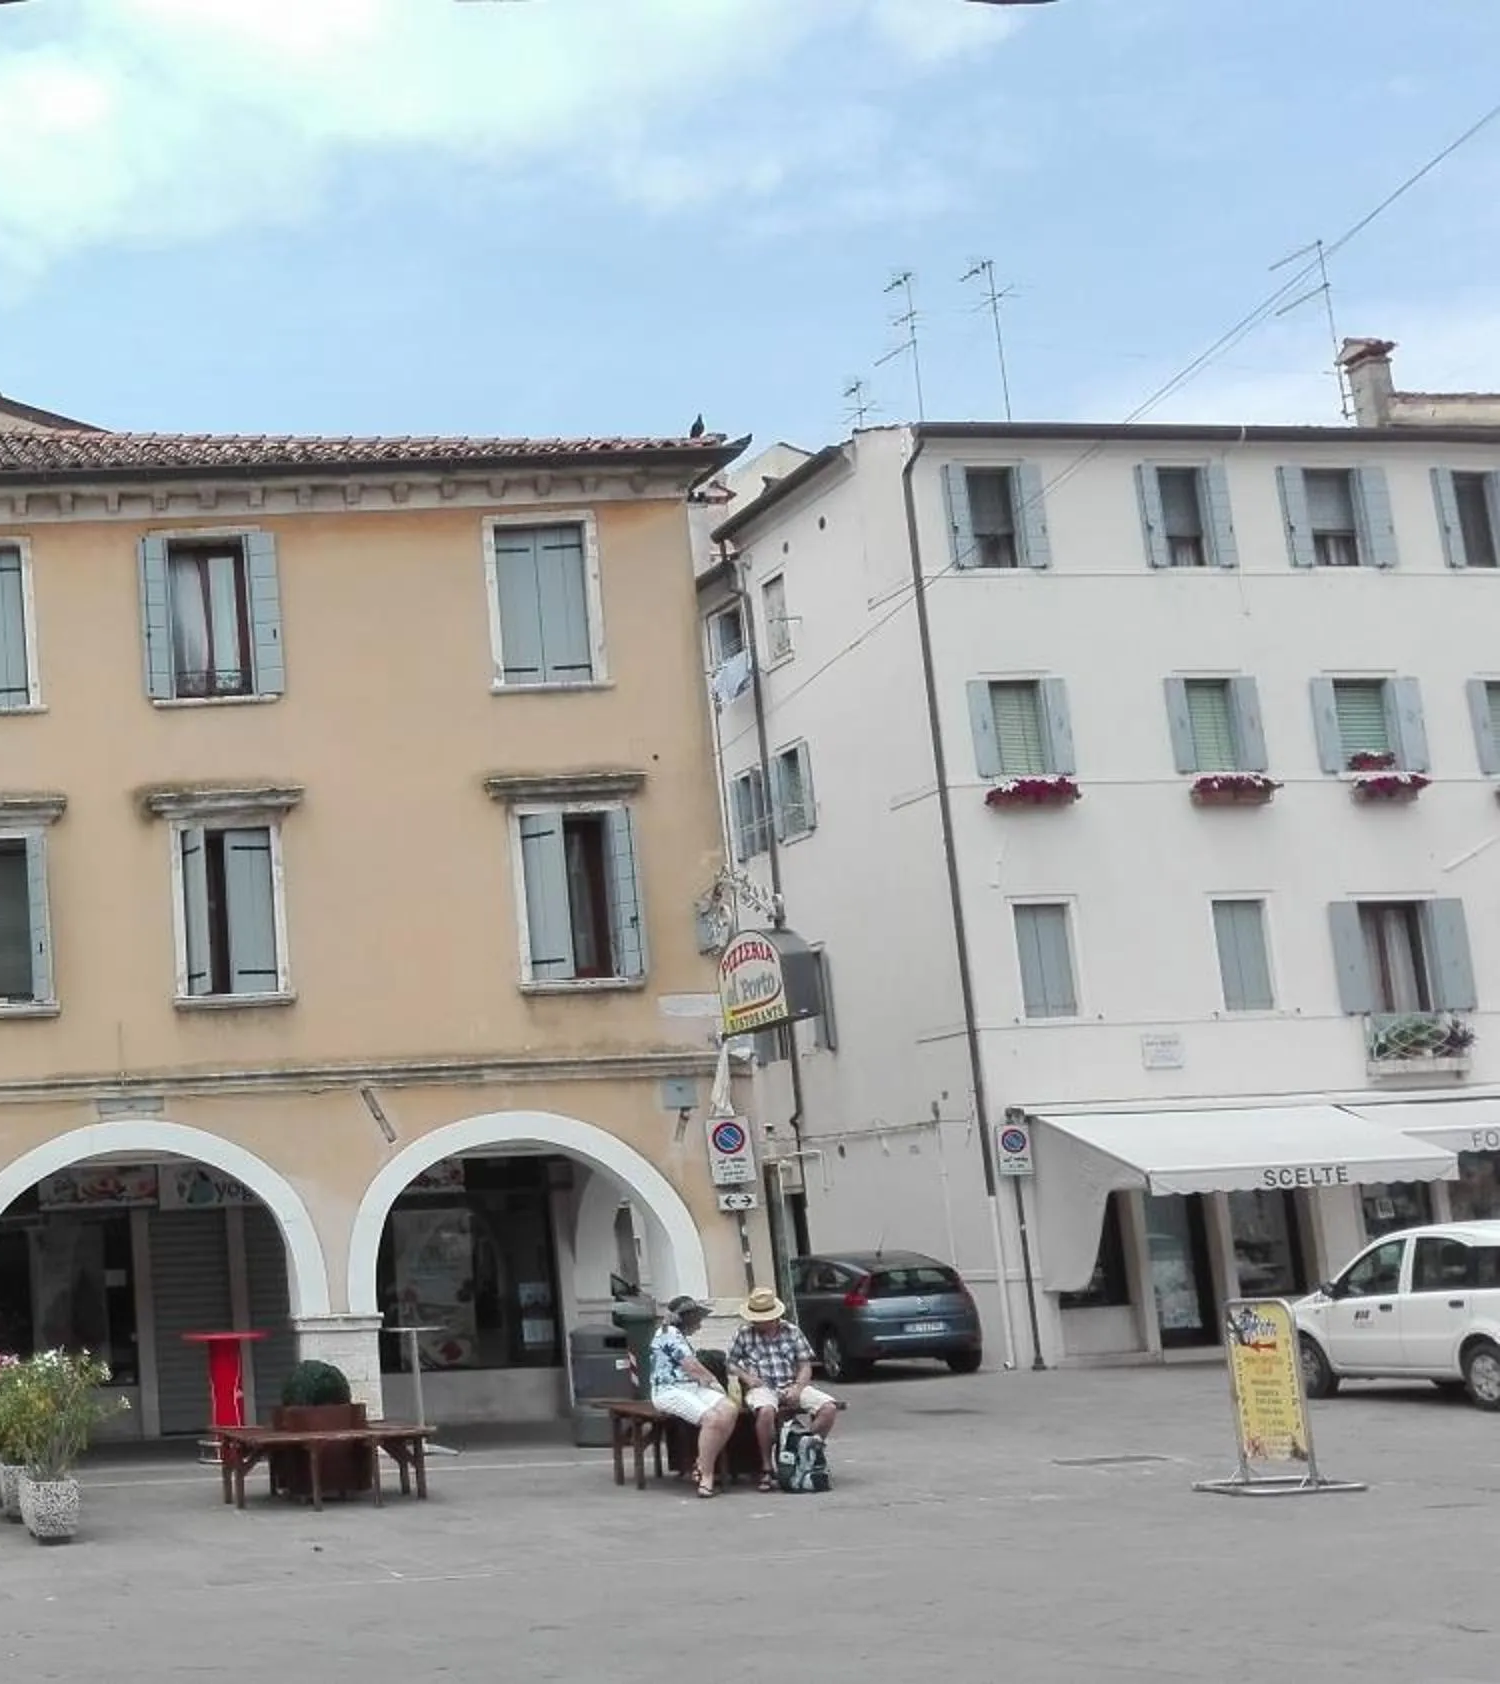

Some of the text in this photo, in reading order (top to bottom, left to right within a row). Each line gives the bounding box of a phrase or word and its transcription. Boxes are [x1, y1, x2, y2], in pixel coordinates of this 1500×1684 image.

[721, 941, 775, 981] PIZZERIA
[740, 970, 775, 1002] Porto
[729, 1003, 786, 1031] RISTORANTE
[1263, 1166, 1349, 1187] SCELTE
